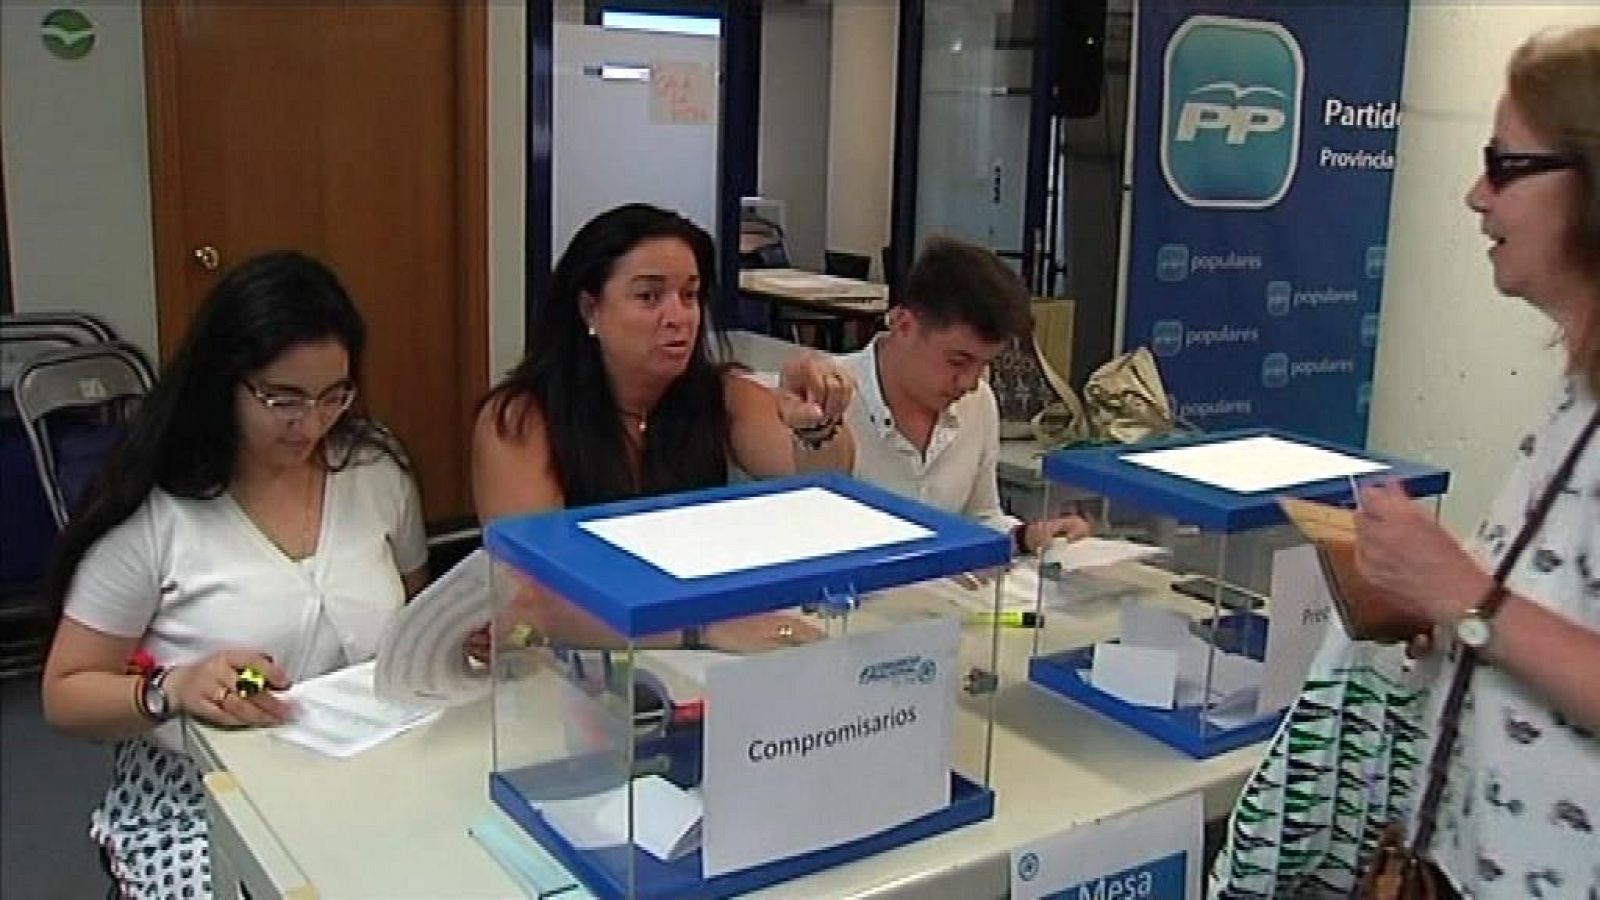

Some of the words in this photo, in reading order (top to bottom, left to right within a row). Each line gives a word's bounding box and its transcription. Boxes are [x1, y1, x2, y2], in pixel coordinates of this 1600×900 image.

[1190, 250, 1262, 272] populares
[1293, 288, 1358, 308] populares
[1186, 325, 1258, 347] populares
[1290, 358, 1353, 376] populares
[747, 704, 918, 763] Compromisarios
